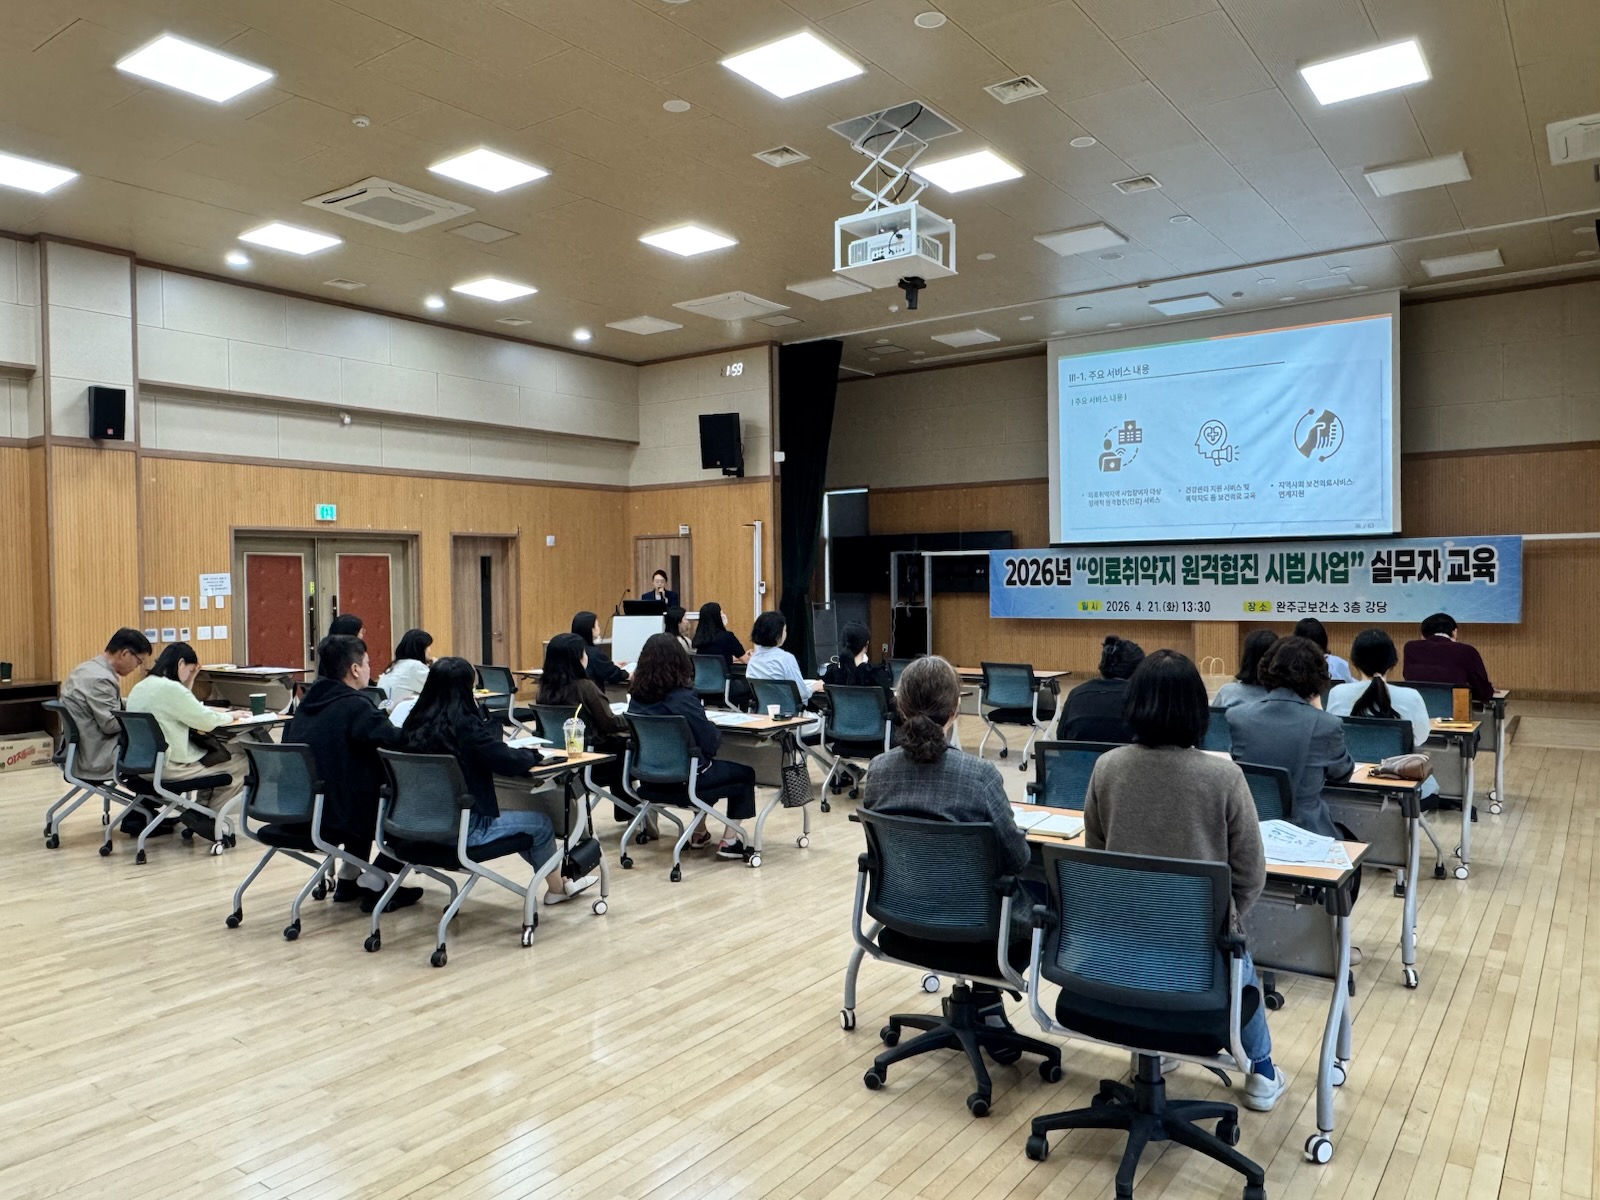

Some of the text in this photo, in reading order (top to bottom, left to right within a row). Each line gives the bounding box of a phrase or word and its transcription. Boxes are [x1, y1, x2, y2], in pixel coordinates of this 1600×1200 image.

[1089, 369, 1105, 380] 주요
[1107, 366, 1131, 378] 서비스
[1133, 364, 1150, 375] 내용
[1075, 393, 1123, 406] 주요 서비스 내용
[1223, 483, 1242, 492] 서비스
[1278, 478, 1353, 489] 지역사회 보건의료서비스
[1143, 496, 1161, 504] 서비스
[1005, 547, 1496, 586] 2026년 “의료취약지 원격협진 시범사업” 실무자 교육
[1106, 601, 1132, 612] 2026.
[1136, 601, 1144, 612] 4.
[1182, 601, 1210, 612] 13:30
[1276, 601, 1387, 614] 완주군보건소 3층 강당
